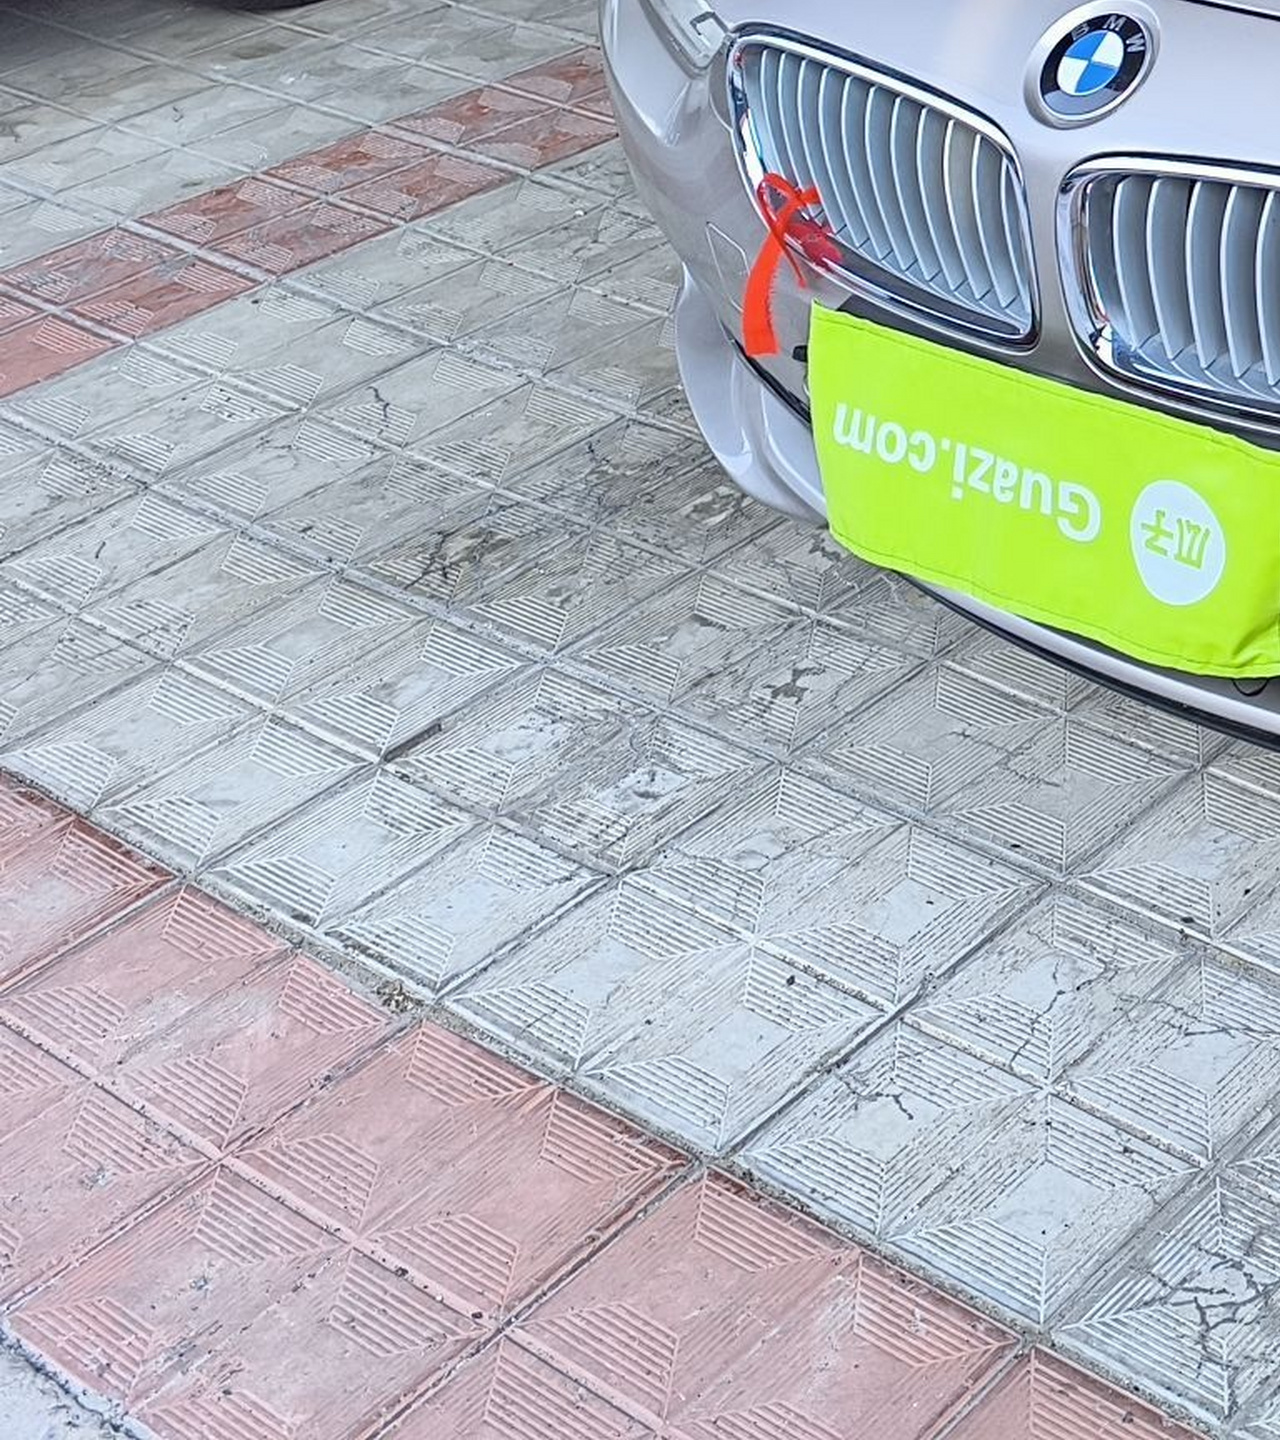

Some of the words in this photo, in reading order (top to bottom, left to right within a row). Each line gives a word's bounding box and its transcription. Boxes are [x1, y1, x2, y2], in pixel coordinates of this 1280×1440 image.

[1071, 14, 1147, 54] BMW
[832, 402, 1101, 543] Guazi.com
[1140, 506, 1212, 572] 瓜子
